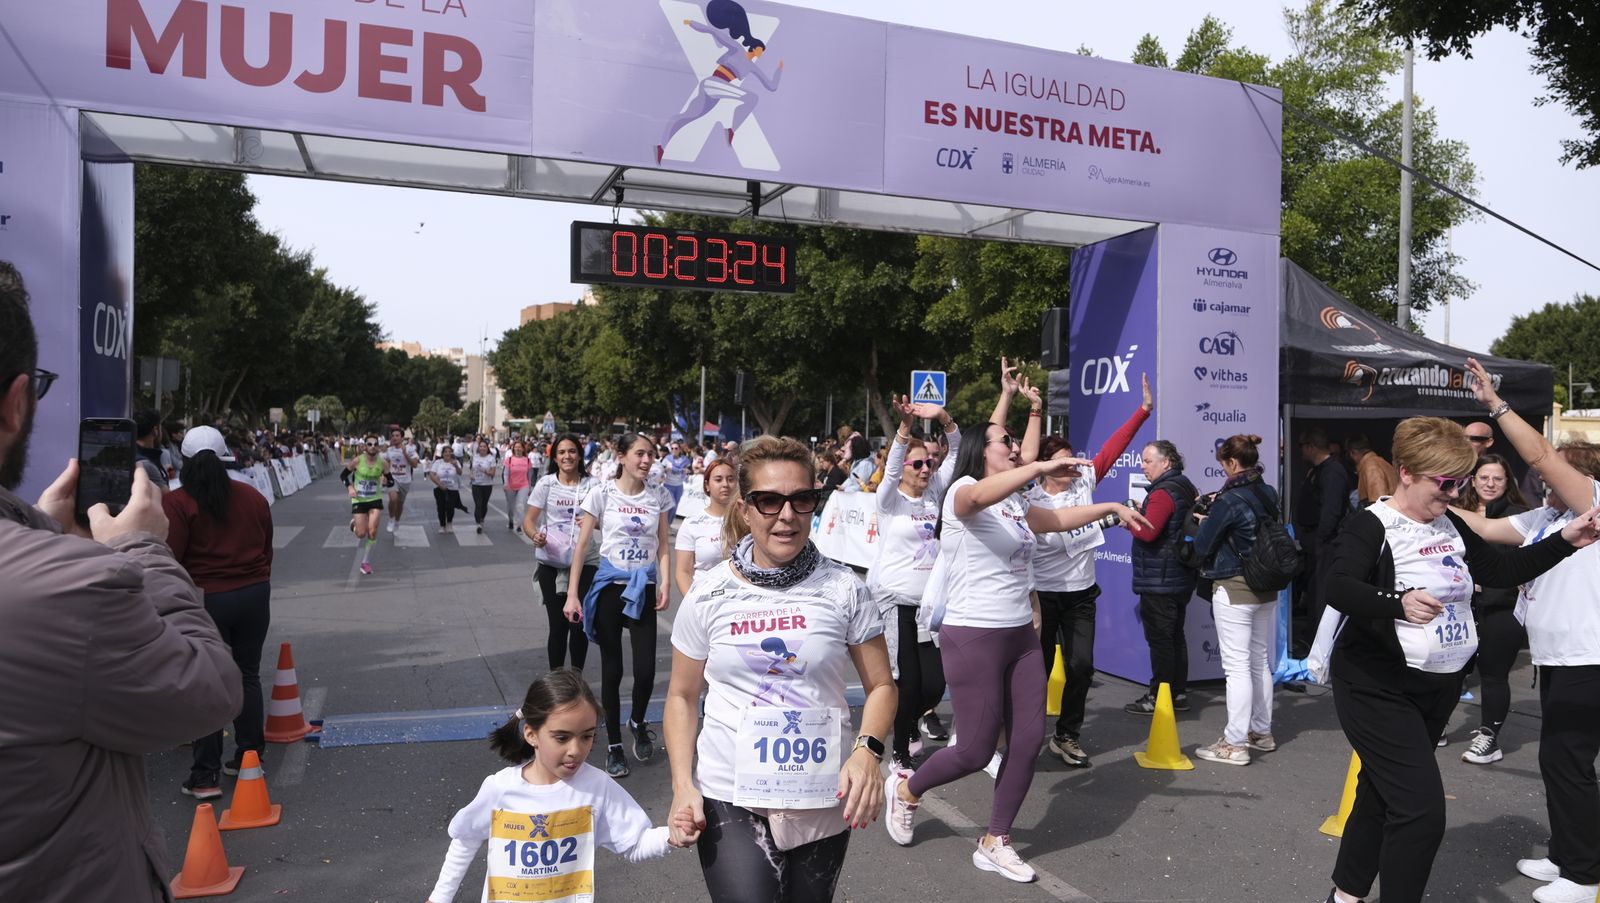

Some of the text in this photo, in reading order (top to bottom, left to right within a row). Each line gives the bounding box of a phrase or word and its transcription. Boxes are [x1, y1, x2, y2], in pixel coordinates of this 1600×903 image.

[106, 0, 486, 112] MUJER
[967, 65, 1126, 111] LA IGUALDAD
[924, 100, 1161, 154] ES NUESTRA META.
[936, 147, 977, 170] CDX
[1023, 156, 1066, 171] ALMERÍA
[612, 231, 785, 285] 00:23:24
[1197, 267, 1248, 279] HYUNDAI
[1210, 301, 1251, 314] cajamar
[93, 302, 127, 359] CDX
[1199, 336, 1236, 355] CASI
[1080, 348, 1136, 396] CDX
[1211, 369, 1248, 382] vithas
[1202, 410, 1246, 424] aqualia
[619, 549, 649, 560] 1244
[735, 606, 802, 621] CARRERA DE LA
[730, 615, 807, 636] MUJER
[1435, 621, 1469, 643] 1321
[754, 737, 827, 764] 1096
[778, 764, 804, 772] ALICIA
[504, 823, 525, 831] MUJER
[504, 836, 578, 868] 1602
[521, 866, 559, 875] MARTINA
